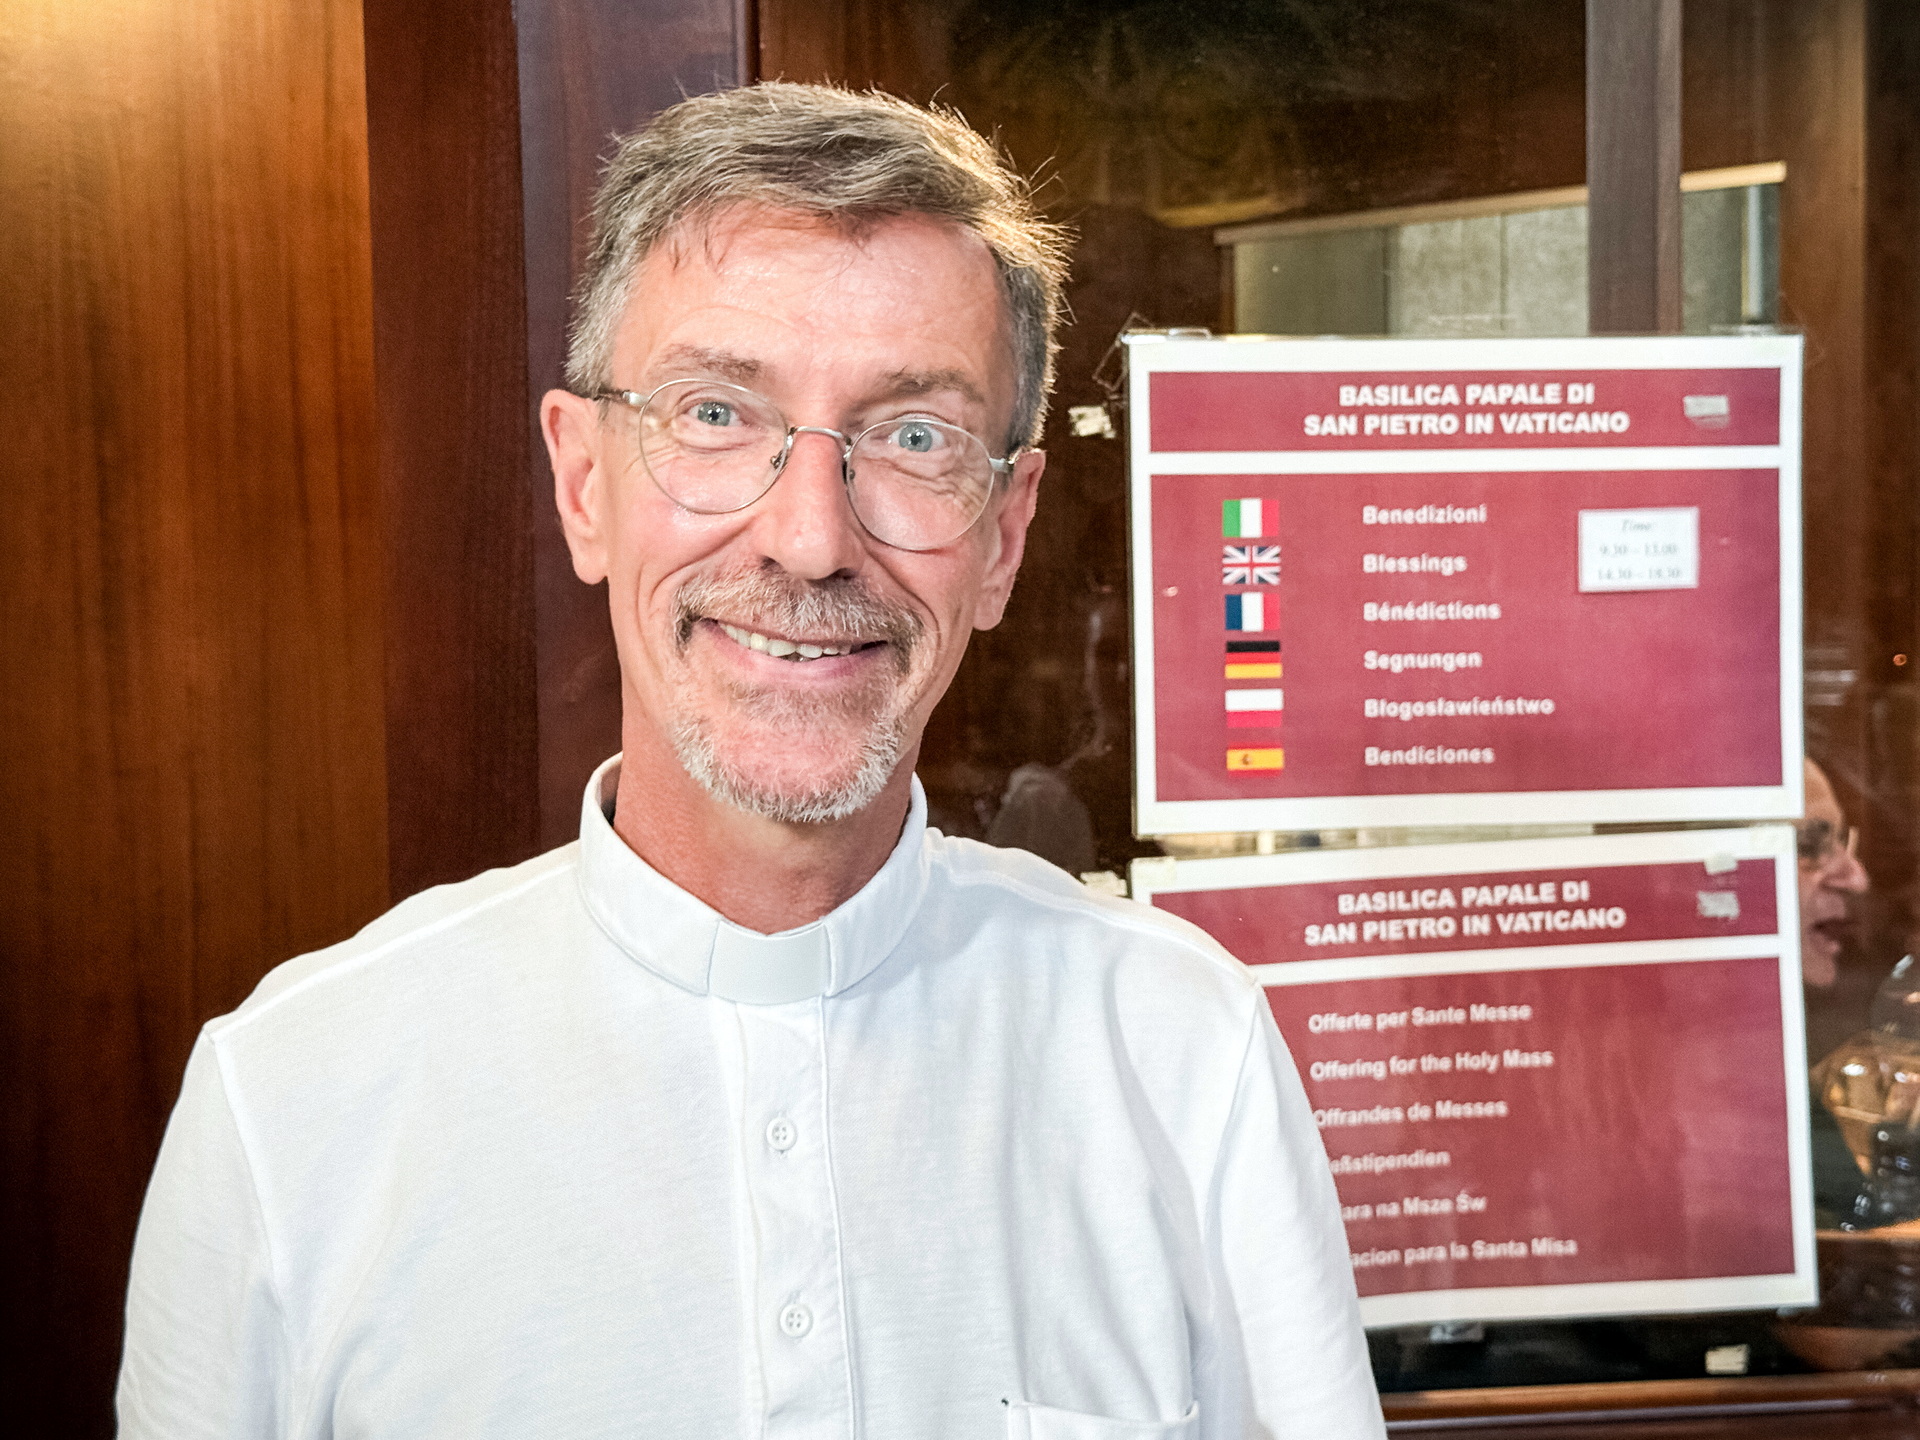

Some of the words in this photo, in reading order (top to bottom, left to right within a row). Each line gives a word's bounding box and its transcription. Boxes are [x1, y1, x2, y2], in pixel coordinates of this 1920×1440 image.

[1339, 384, 1460, 406] BASILICA
[1465, 383, 1562, 405] PAPALE
[1567, 382, 1595, 404] DI
[1304, 414, 1358, 436] SAN
[1363, 413, 1459, 435] PIETRO
[1465, 412, 1494, 434] IN
[1499, 411, 1631, 434] VATICANO
[1363, 503, 1487, 525] Benedizioni
[1363, 553, 1468, 576] Blessings
[1363, 600, 1501, 622] Bénédictions
[1364, 650, 1483, 673] Segnungen
[1364, 745, 1495, 766] Bendiciones
[1338, 888, 1456, 915] BASILICA
[1461, 881, 1556, 908] PAPALE
[1562, 880, 1589, 902] DI
[1304, 922, 1357, 946] SAN
[1362, 915, 1456, 942] PIETRO
[1462, 914, 1491, 936] IN
[1496, 906, 1626, 934] VATICANO
[1308, 1012, 1373, 1034] Offerte
[1376, 1010, 1408, 1032] per
[1469, 1003, 1532, 1023] Messe
[1310, 1058, 1387, 1081] Offering
[1389, 1055, 1417, 1075] for
[1420, 1053, 1452, 1073] the
[1455, 1051, 1499, 1074] Holy
[1502, 1049, 1554, 1069] Mass
[1314, 1105, 1405, 1128] Offrandes
[1407, 1102, 1432, 1122] de
[1435, 1100, 1508, 1119] Messes
[1329, 1149, 1450, 1175] eßstipendien
[1341, 1204, 1373, 1221] ara
[1376, 1202, 1400, 1218] na
[1351, 1249, 1400, 1268] acion
[1404, 1246, 1447, 1266] para
[1450, 1241, 1469, 1260] la
[1472, 1239, 1528, 1260] Santa
[1531, 1236, 1578, 1256] Misa
